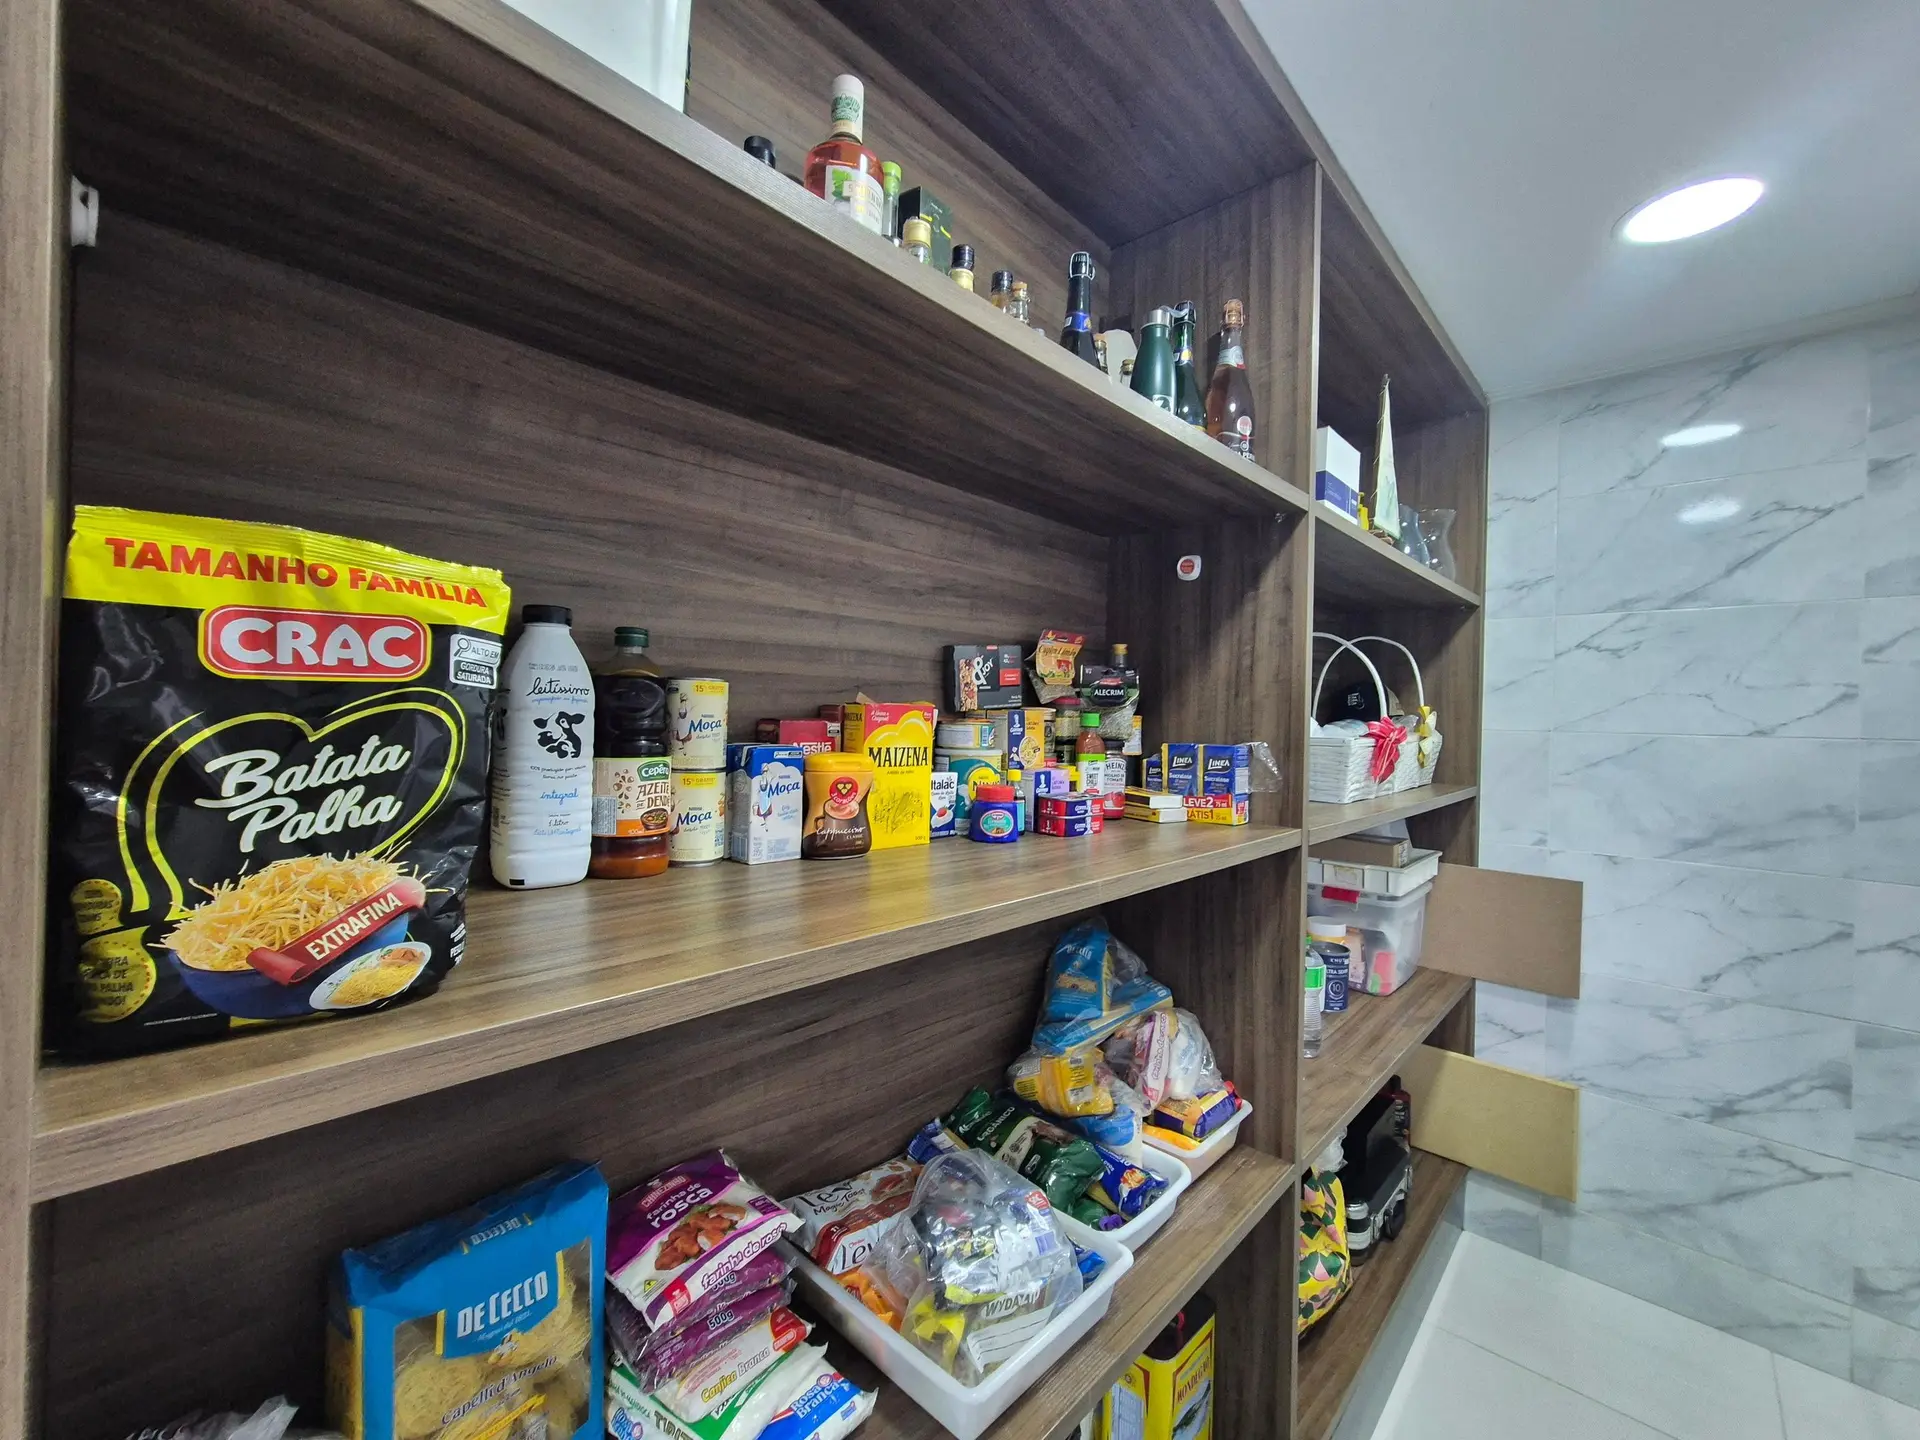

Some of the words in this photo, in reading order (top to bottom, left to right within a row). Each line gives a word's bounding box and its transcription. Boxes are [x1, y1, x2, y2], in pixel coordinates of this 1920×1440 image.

[104, 537, 338, 588] TAMANHO
[349, 567, 487, 608] FAMÍLIA
[219, 617, 415, 668] CRAC
[471, 646, 489, 657] ALTO
[456, 671, 492, 685] SATURADA
[460, 661, 490, 675] GORDURA
[526, 676, 590, 697] leitíssimo
[1094, 688, 1125, 697] ALECRIM
[689, 718, 722, 734] Moça
[868, 746, 929, 768] MAIZENA
[1172, 756, 1193, 768] LINEA
[1208, 758, 1230, 770] LINEA
[194, 734, 412, 809] Batata
[540, 788, 579, 806] integral
[767, 781, 801, 798] Moça
[227, 784, 403, 853] Palha
[677, 811, 713, 827] Moça
[304, 891, 404, 961] EXTRAFINA
[646, 1189, 687, 1221] farinha
[687, 1181, 702, 1194] de
[797, 1181, 853, 1207] Lev
[813, 1201, 845, 1216] Magic
[840, 1187, 867, 1204] Toast
[650, 1187, 714, 1230] rosca
[700, 1252, 744, 1292] farinha
[743, 1241, 762, 1258] de
[456, 1302, 487, 1339] DE
[488, 1270, 550, 1325] CECCO
[708, 1310, 735, 1330] 500g
[701, 1370, 738, 1403] Canjica
[737, 1348, 771, 1377] Branca
[441, 1384, 496, 1426] Capelli
[790, 1384, 823, 1411] Rosa
[796, 1380, 840, 1419] Branca
